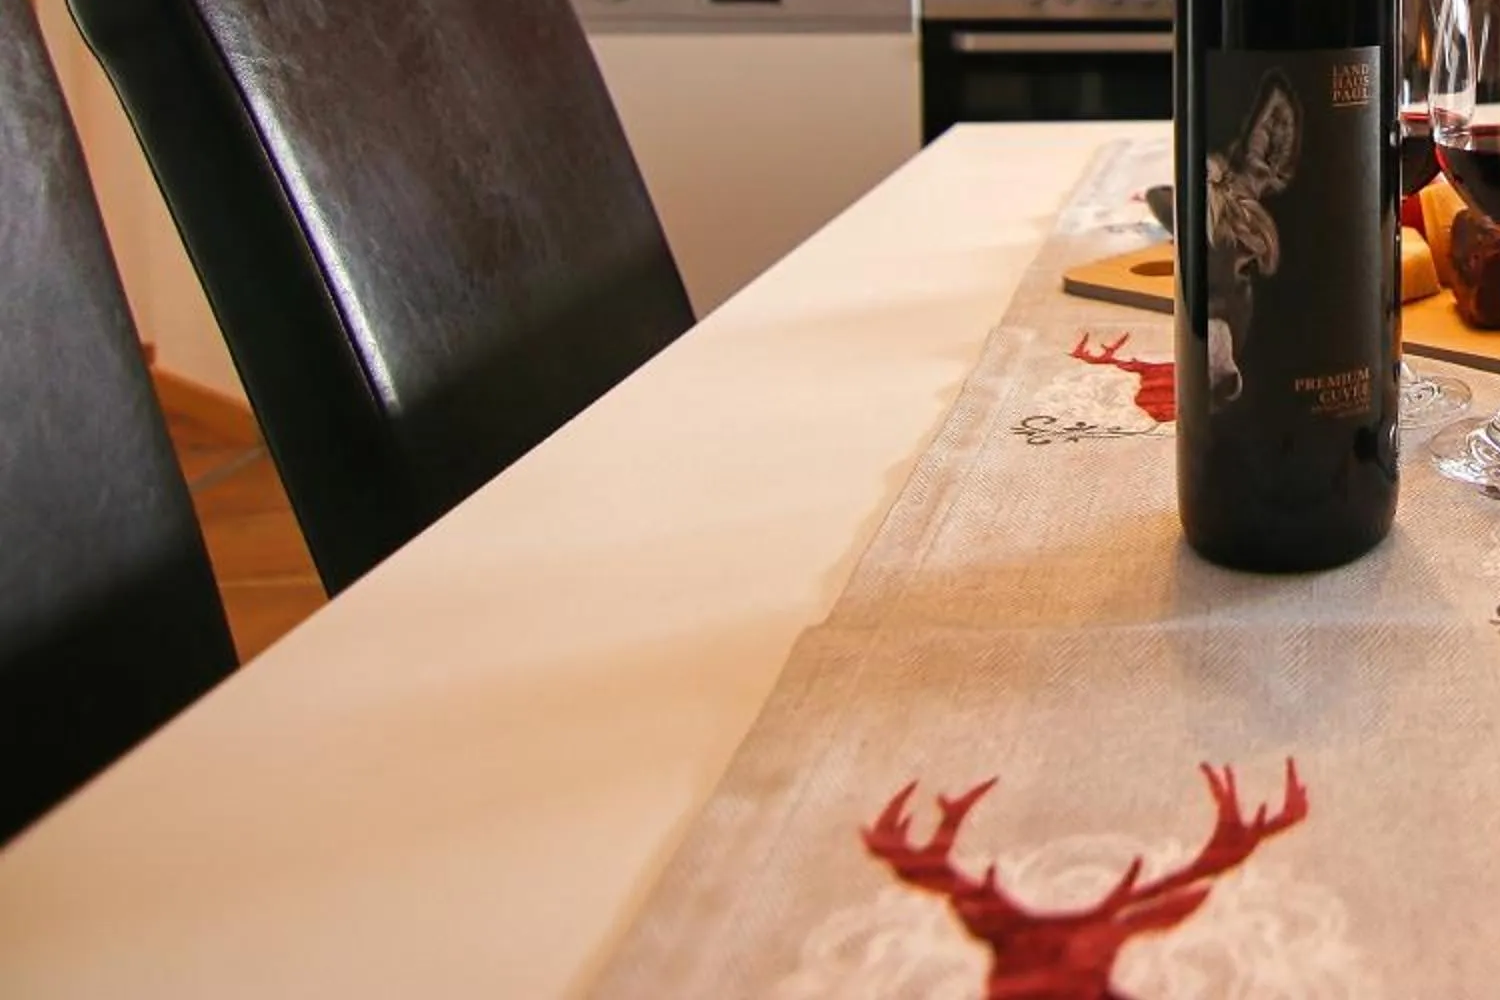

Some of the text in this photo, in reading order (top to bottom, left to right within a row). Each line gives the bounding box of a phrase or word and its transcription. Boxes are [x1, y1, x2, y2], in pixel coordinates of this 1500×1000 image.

[1332, 63, 1369, 76] LAND
[1332, 76, 1369, 89] HAUS
[1332, 88, 1369, 101] PAUL
[1294, 367, 1369, 391] PREMIUM
